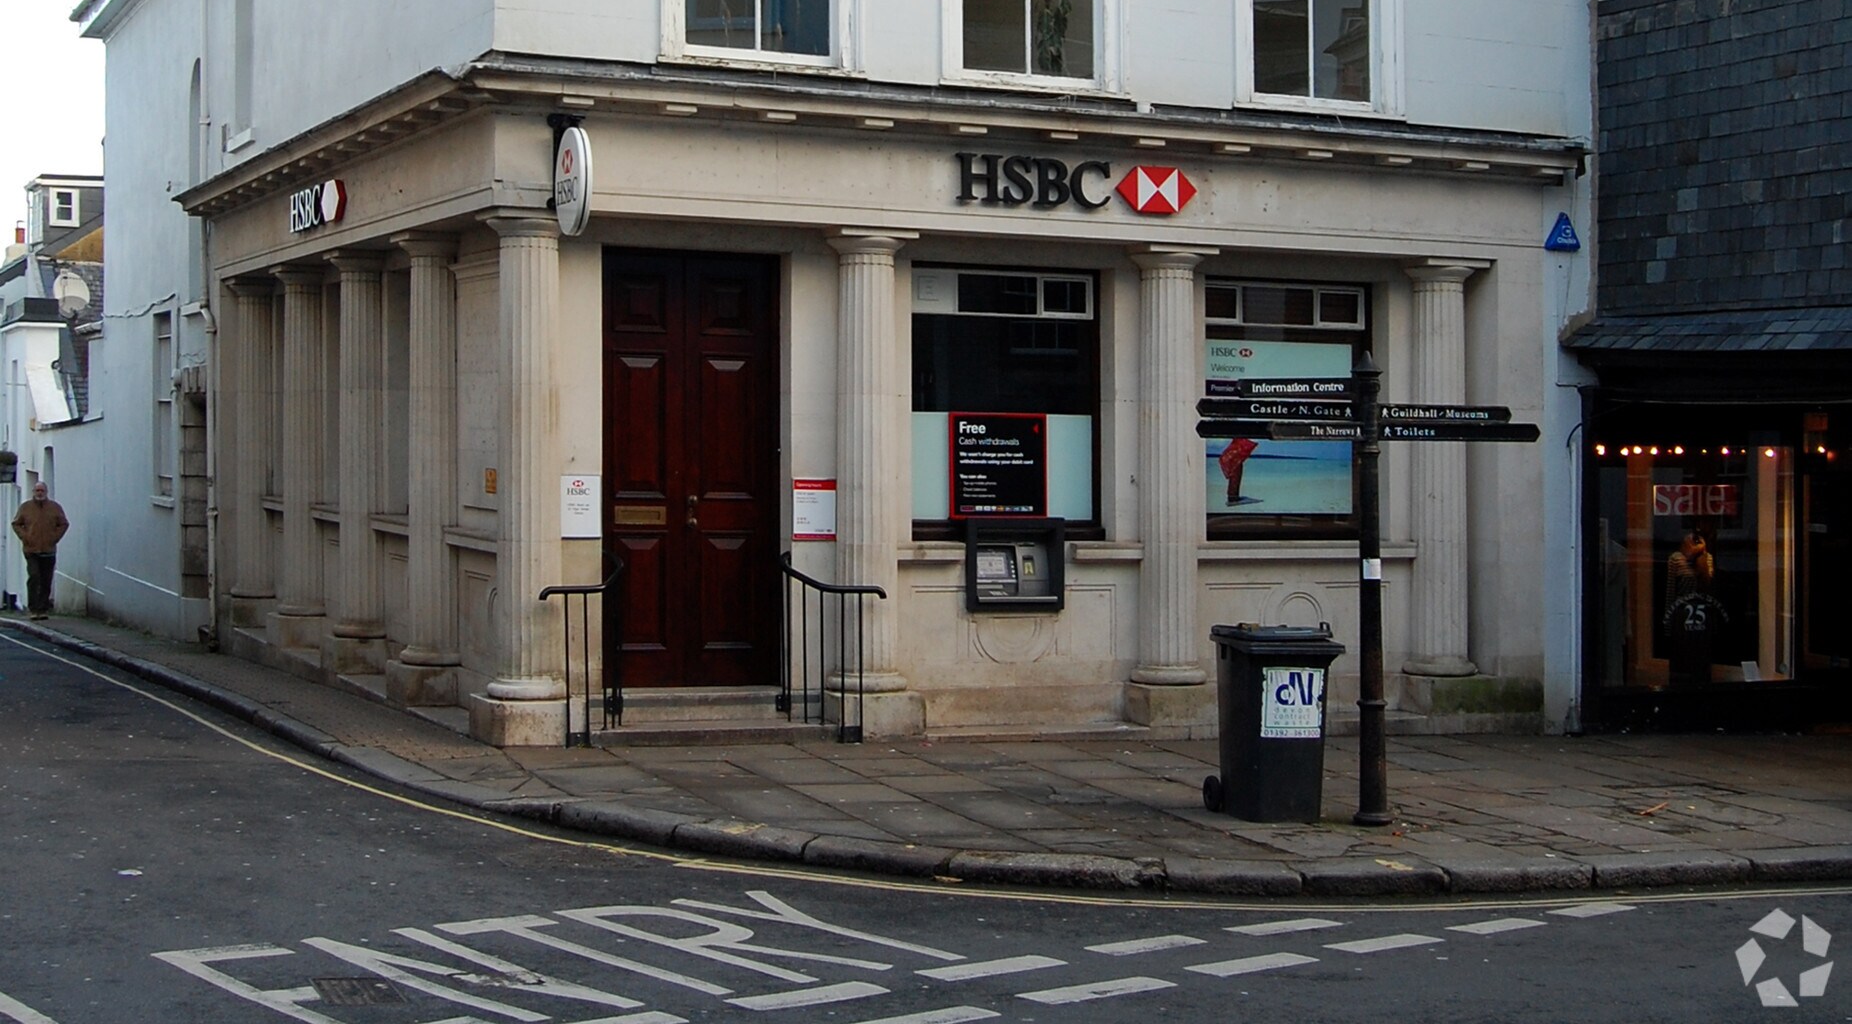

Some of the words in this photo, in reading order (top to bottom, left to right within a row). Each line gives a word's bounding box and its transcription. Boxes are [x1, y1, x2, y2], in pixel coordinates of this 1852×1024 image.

[955, 151, 1112, 209] HSBC
[557, 176, 579, 207] HSBC
[289, 184, 322, 233] HSBC
[1210, 347, 1237, 357] HSBC
[1210, 363, 1246, 373] Welcome
[1251, 383, 1310, 393] Information
[1313, 382, 1345, 392] Centre
[1250, 404, 1288, 415] Castle
[1313, 405, 1341, 416] Gate
[1391, 408, 1437, 418] Guildhall
[959, 421, 986, 434] Free
[1310, 426, 1324, 435] The
[1326, 426, 1355, 436] Narrows
[1395, 427, 1436, 436] Toilets
[959, 437, 977, 445] Cash
[978, 437, 1020, 446] withdrawals
[566, 487, 591, 496] HSBC
[1654, 484, 1726, 516] sale
[1684, 604, 1706, 625] 25
[150, 890, 967, 1024] ENTRY
